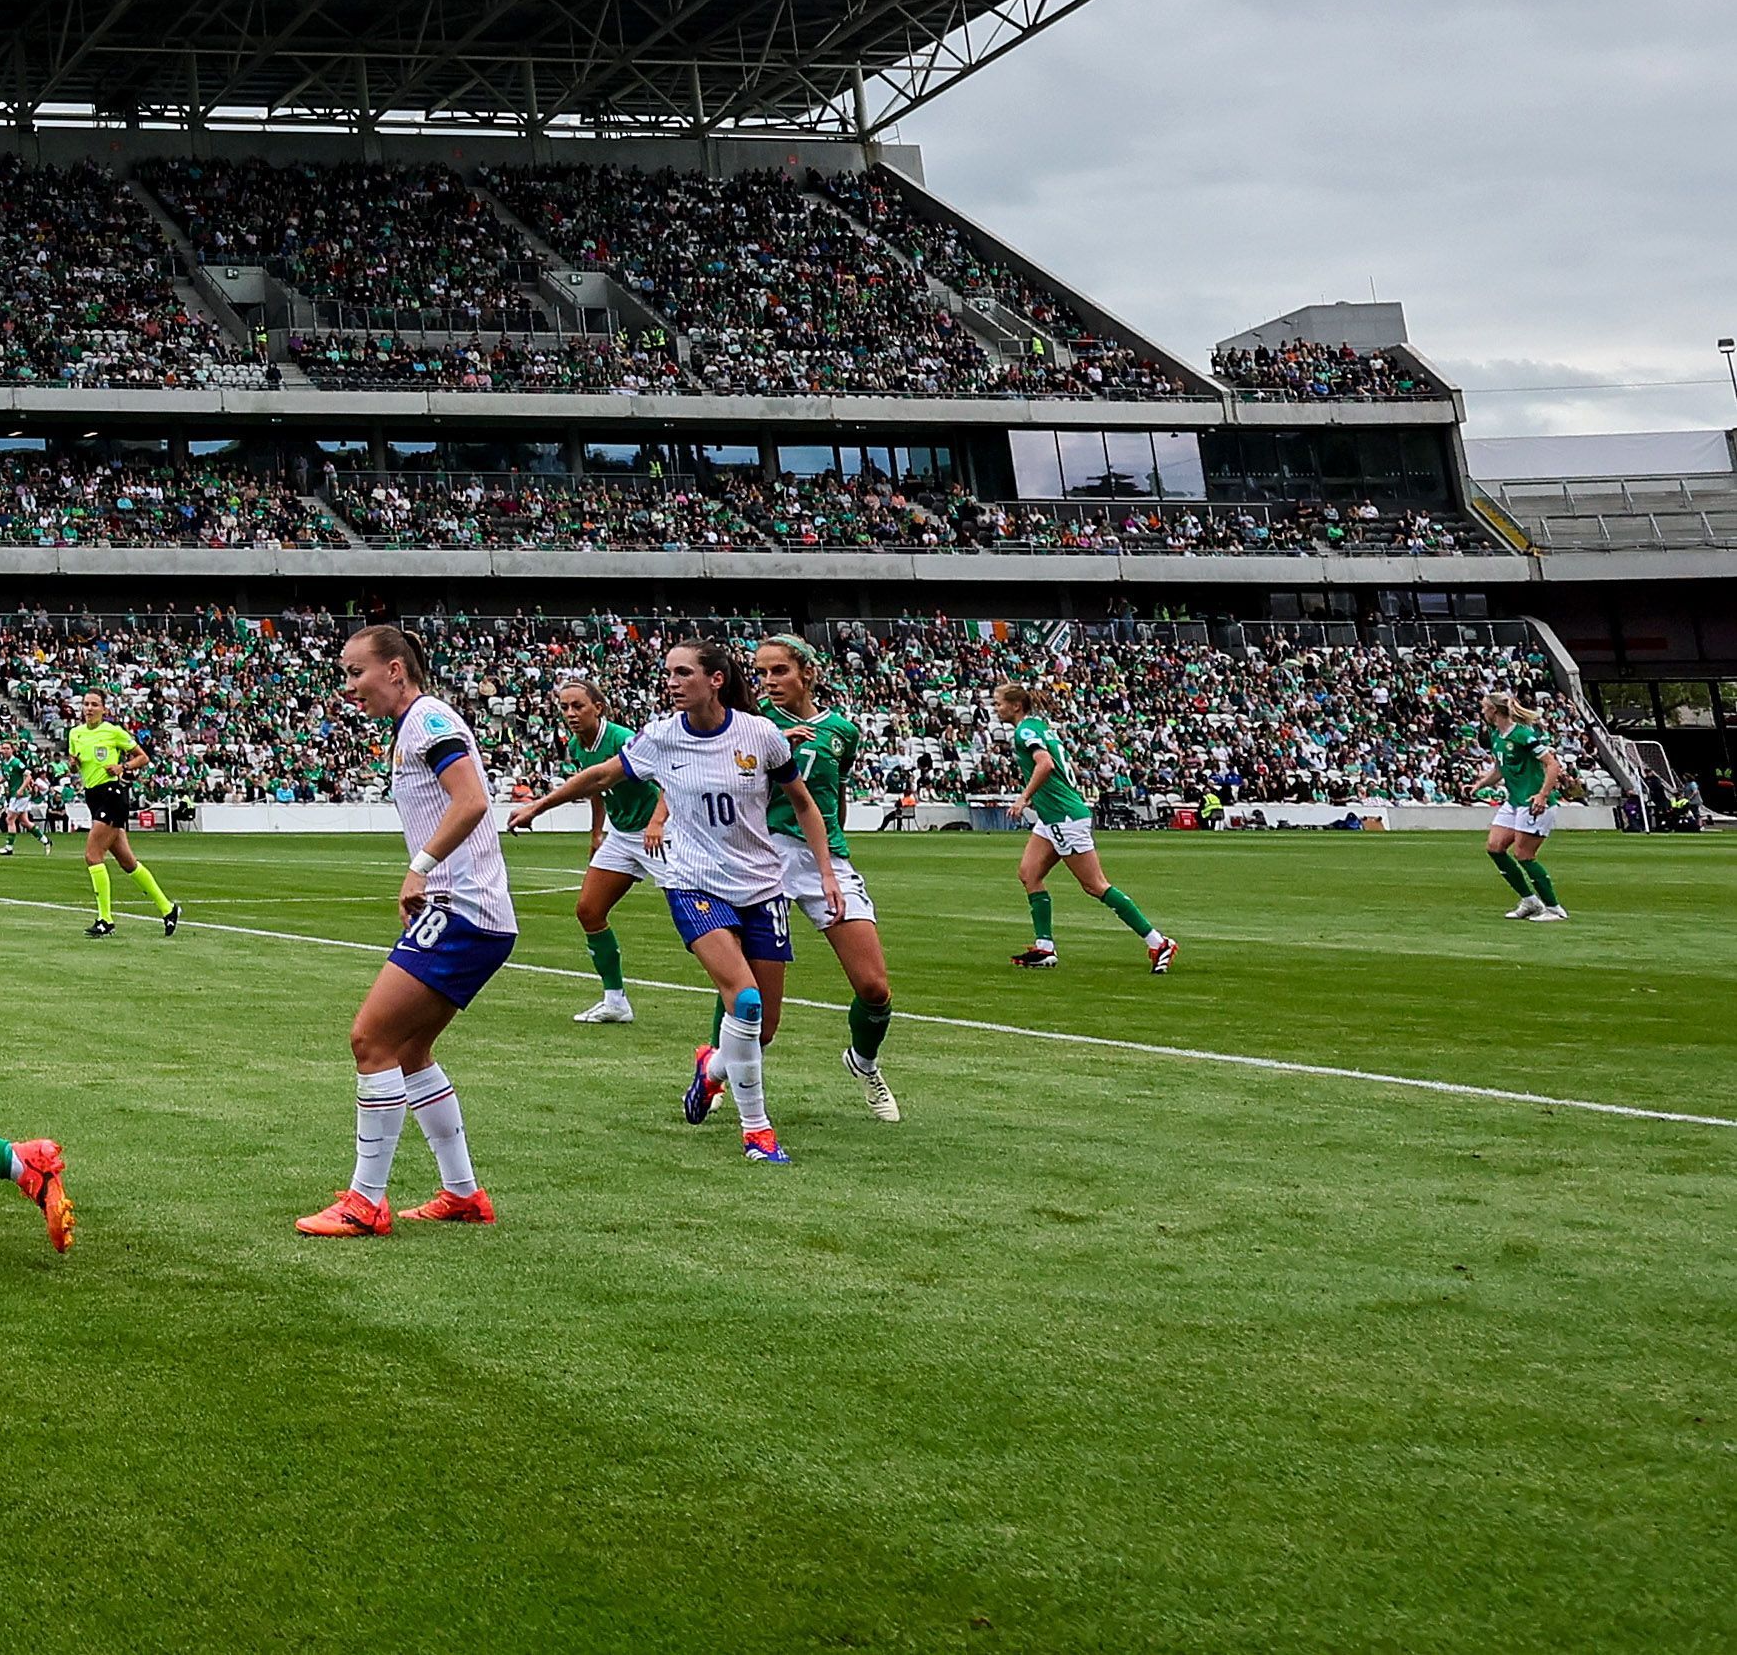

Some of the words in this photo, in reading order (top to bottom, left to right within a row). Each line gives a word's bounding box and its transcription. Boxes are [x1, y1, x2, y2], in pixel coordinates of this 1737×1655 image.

[799, 748, 817, 782] 7
[701, 792, 736, 827] 10
[1051, 824, 1064, 843] 8
[405, 905, 448, 949] 18
[766, 900, 787, 937] 10
